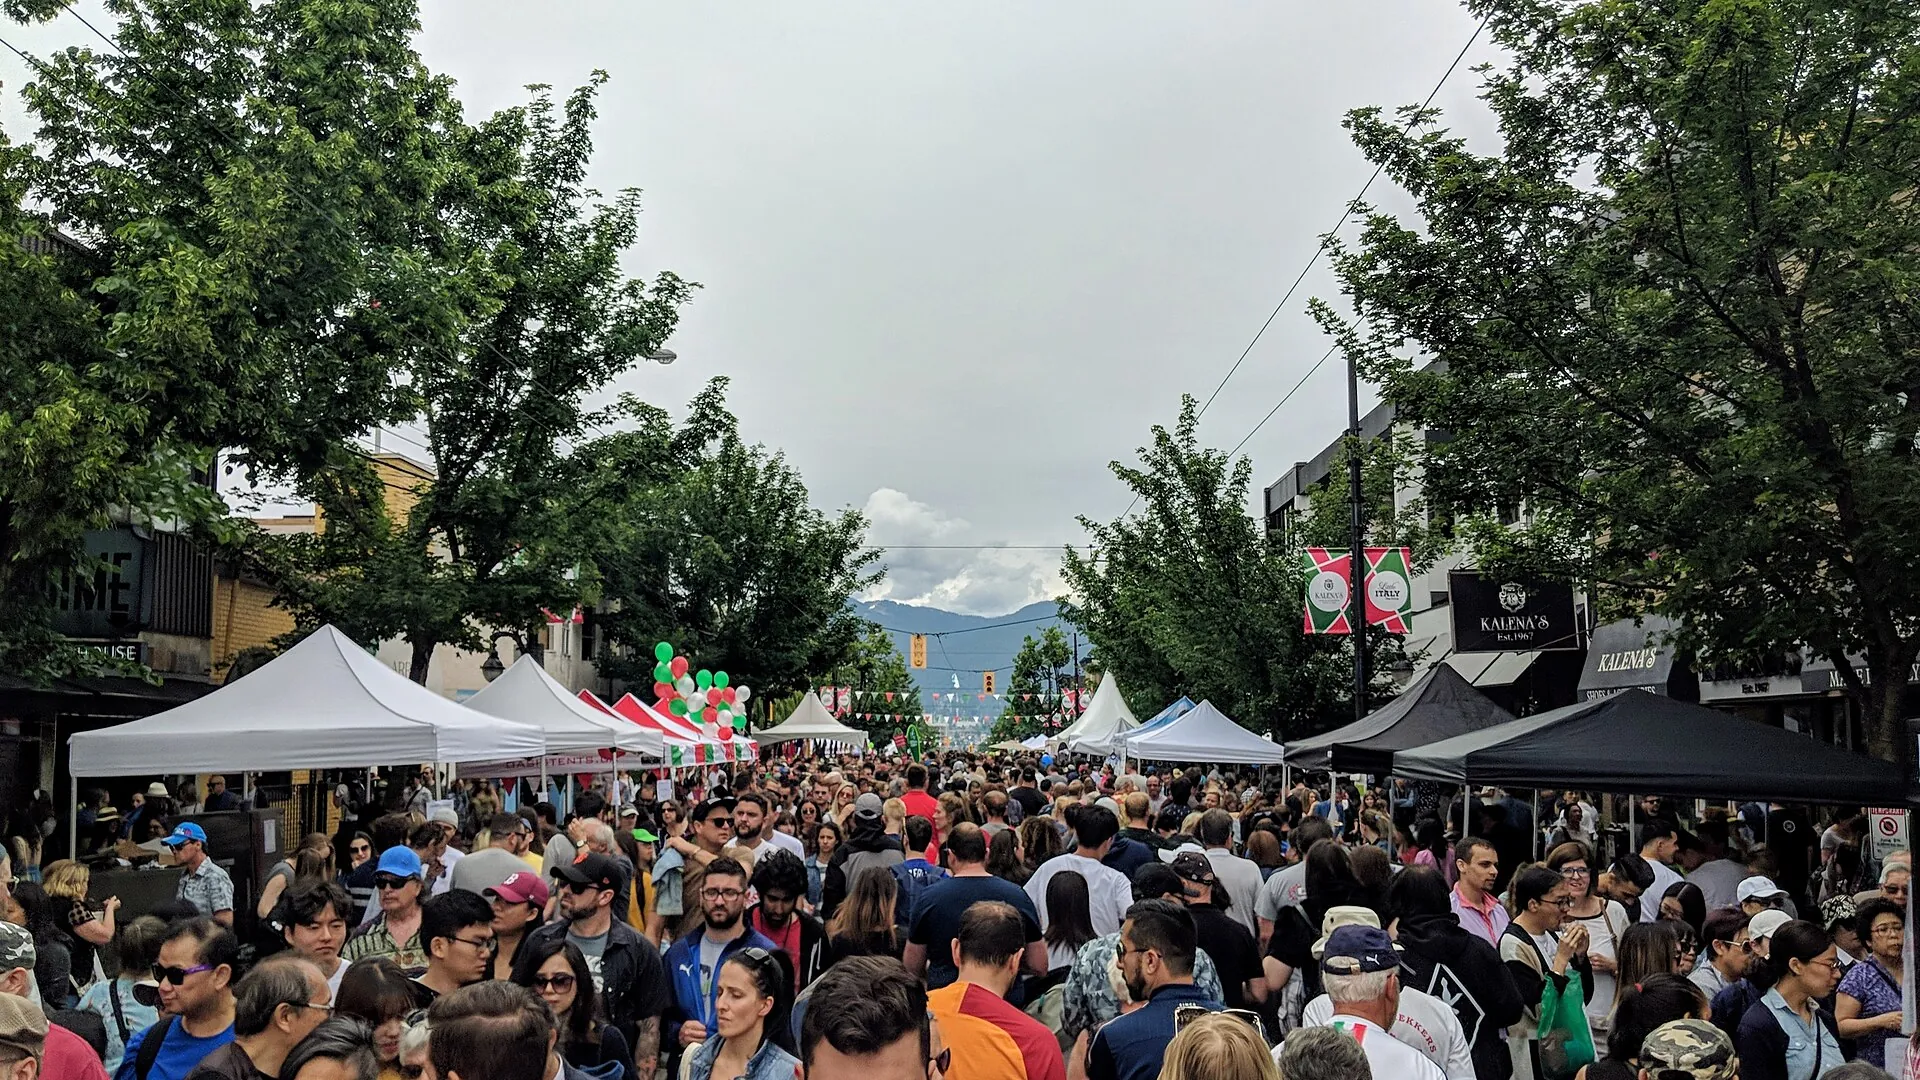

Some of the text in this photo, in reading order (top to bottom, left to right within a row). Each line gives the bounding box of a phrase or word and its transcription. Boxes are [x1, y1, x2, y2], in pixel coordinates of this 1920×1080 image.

[1375, 590, 1401, 598] ITALY
[1481, 615, 1549, 631] KALENA'S
[1597, 647, 1657, 672] KALENA'S
